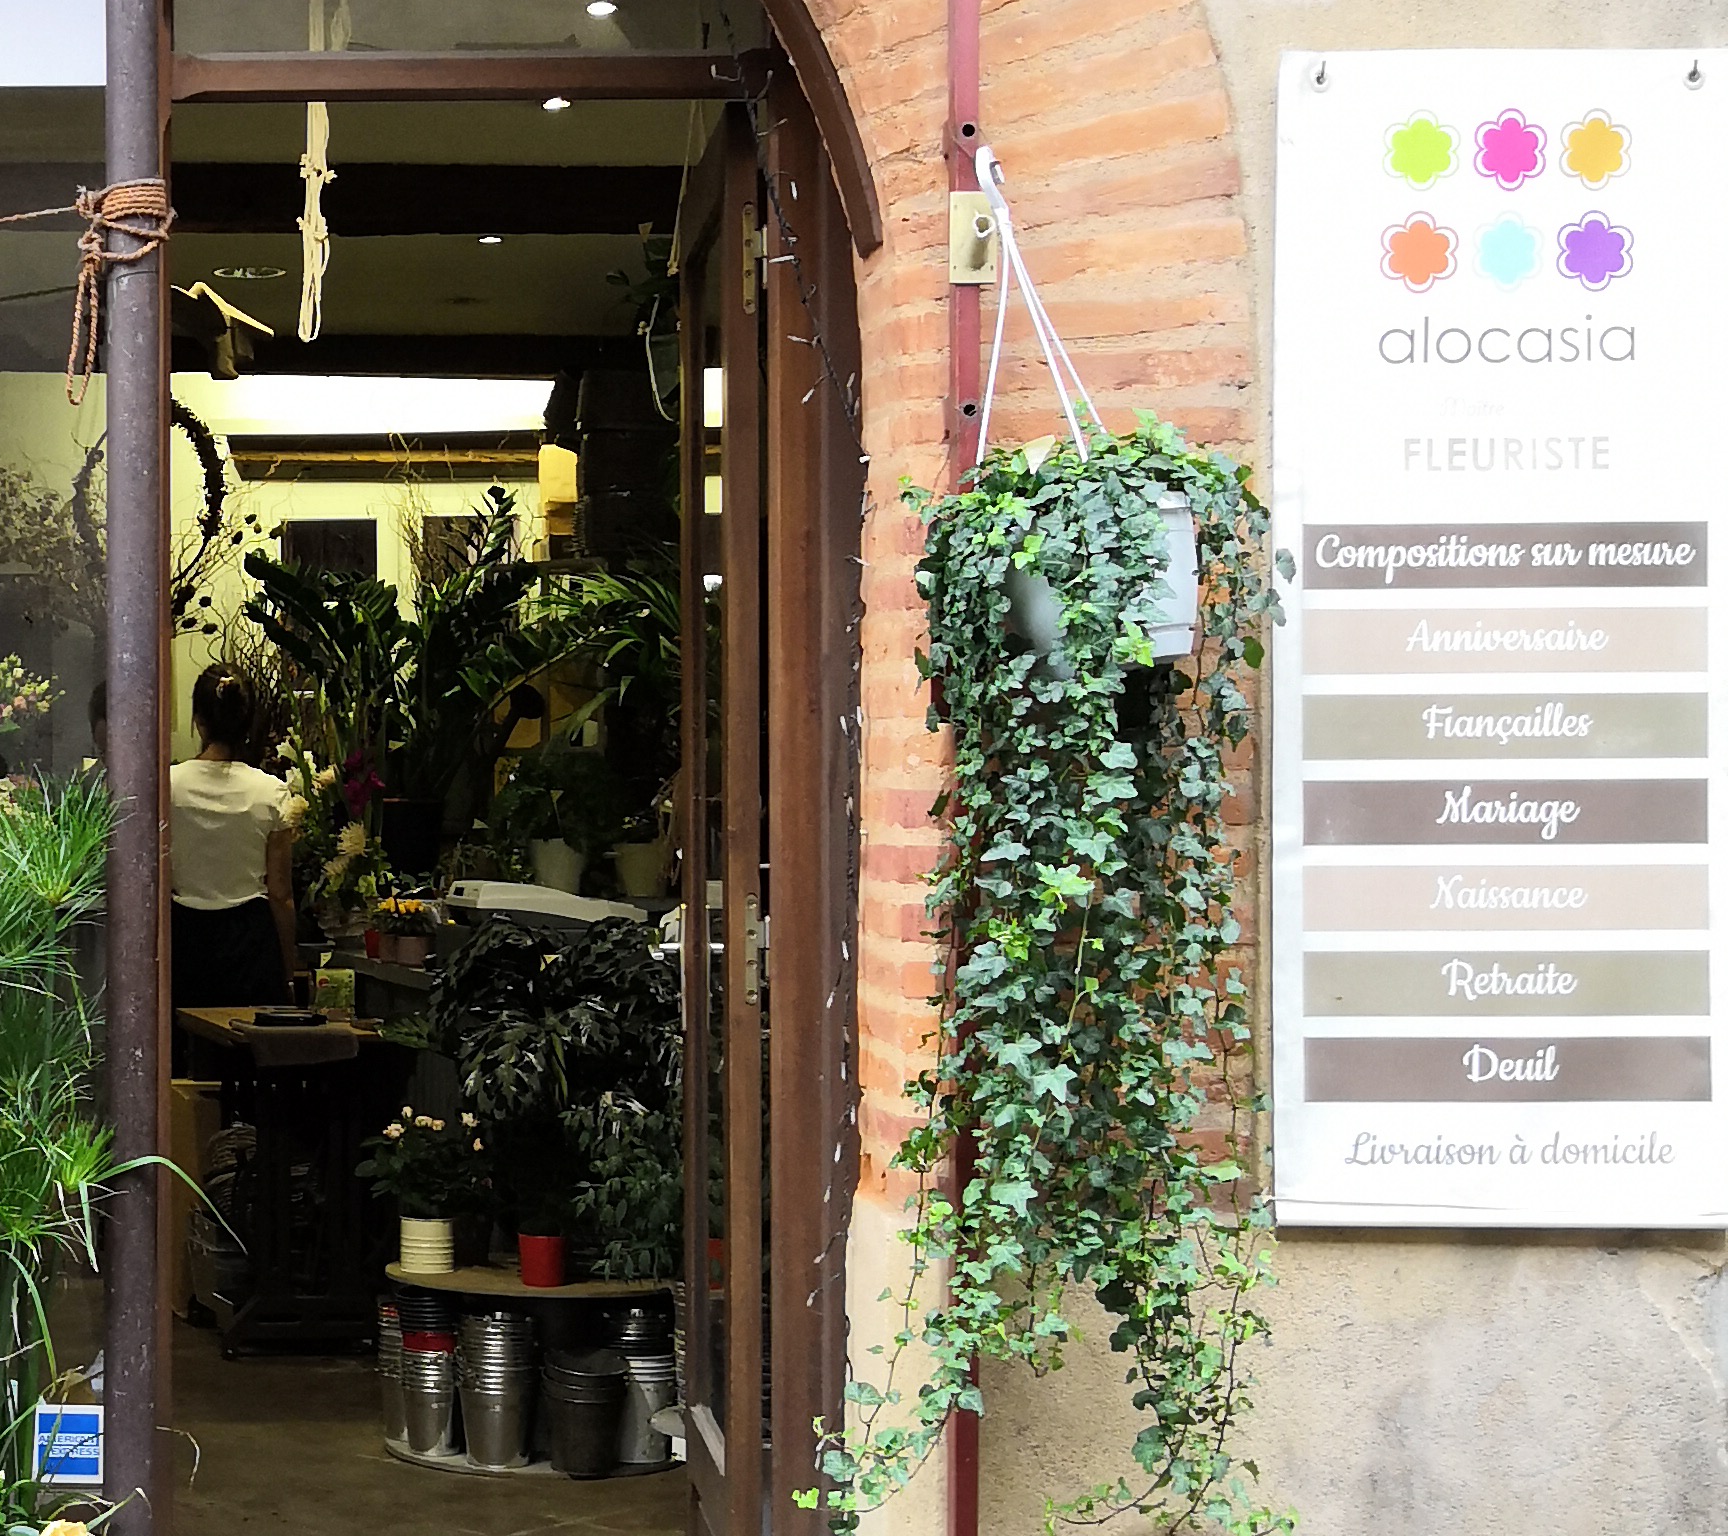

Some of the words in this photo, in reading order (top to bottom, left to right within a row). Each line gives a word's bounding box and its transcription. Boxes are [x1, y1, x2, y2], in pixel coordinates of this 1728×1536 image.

[1378, 313, 1636, 365] alocasia
[1403, 435, 1611, 472] FLEURISTE
[1315, 534, 1525, 585] Compositions
[1530, 542, 1584, 568] sur
[1587, 541, 1697, 568] mesure
[1405, 619, 1610, 653] Anniversaire
[1422, 702, 1594, 745] Fiançailles
[1436, 785, 1581, 840] Mariage
[1429, 874, 1589, 910] Naissance
[1440, 957, 1578, 1002] Retraite
[1462, 1043, 1560, 1083] Deuil
[1343, 1131, 1502, 1167] Livraison
[1508, 1133, 1534, 1166] à
[1539, 1130, 1676, 1166] domicile
